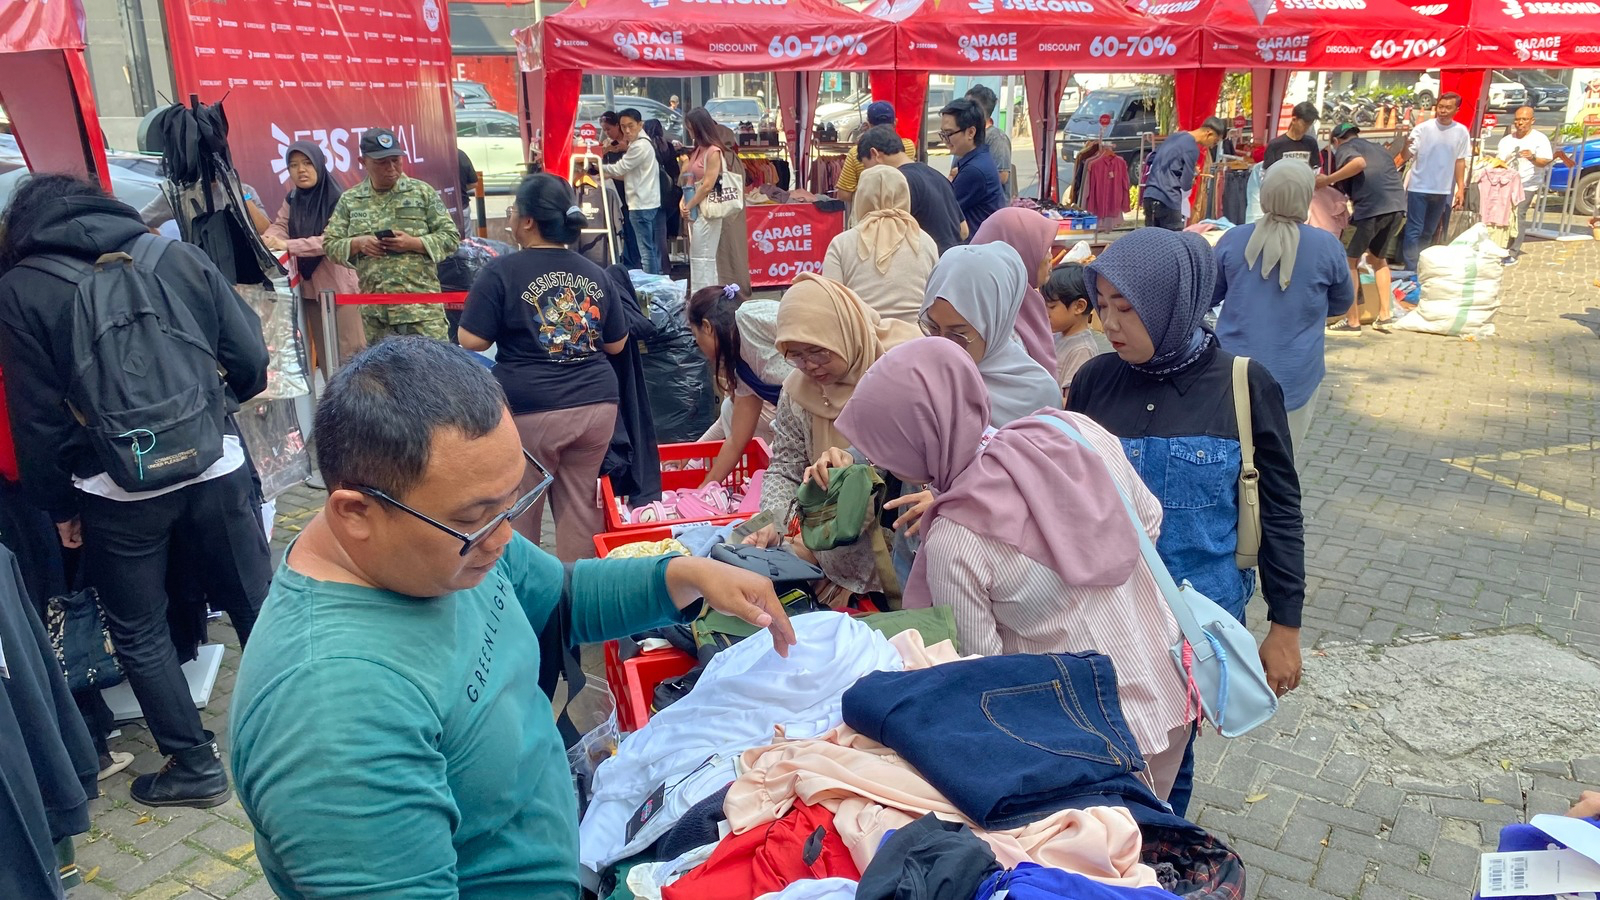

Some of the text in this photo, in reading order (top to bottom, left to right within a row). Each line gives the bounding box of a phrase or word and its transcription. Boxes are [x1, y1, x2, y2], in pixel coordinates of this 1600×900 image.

[613, 31, 683, 46] GARAGE
[709, 34, 867, 58] DISCOUNT 60-70%
[958, 32, 1017, 48] GARAGE
[1257, 36, 1309, 50] GARAGE
[1515, 36, 1561, 50] GARAGE
[643, 47, 685, 61] SALE
[1039, 36, 1176, 58] DISCOUNT 60-70%
[1326, 38, 1446, 60] DISCOUNT 60-70%
[982, 49, 1017, 61] SALE
[1276, 49, 1307, 62] SALE
[1531, 50, 1559, 61] SALE
[752, 224, 812, 242] GARAGE
[777, 239, 812, 252] SALE
[768, 261, 824, 277] 60-70%
[521, 271, 604, 306] RESISTANCE
